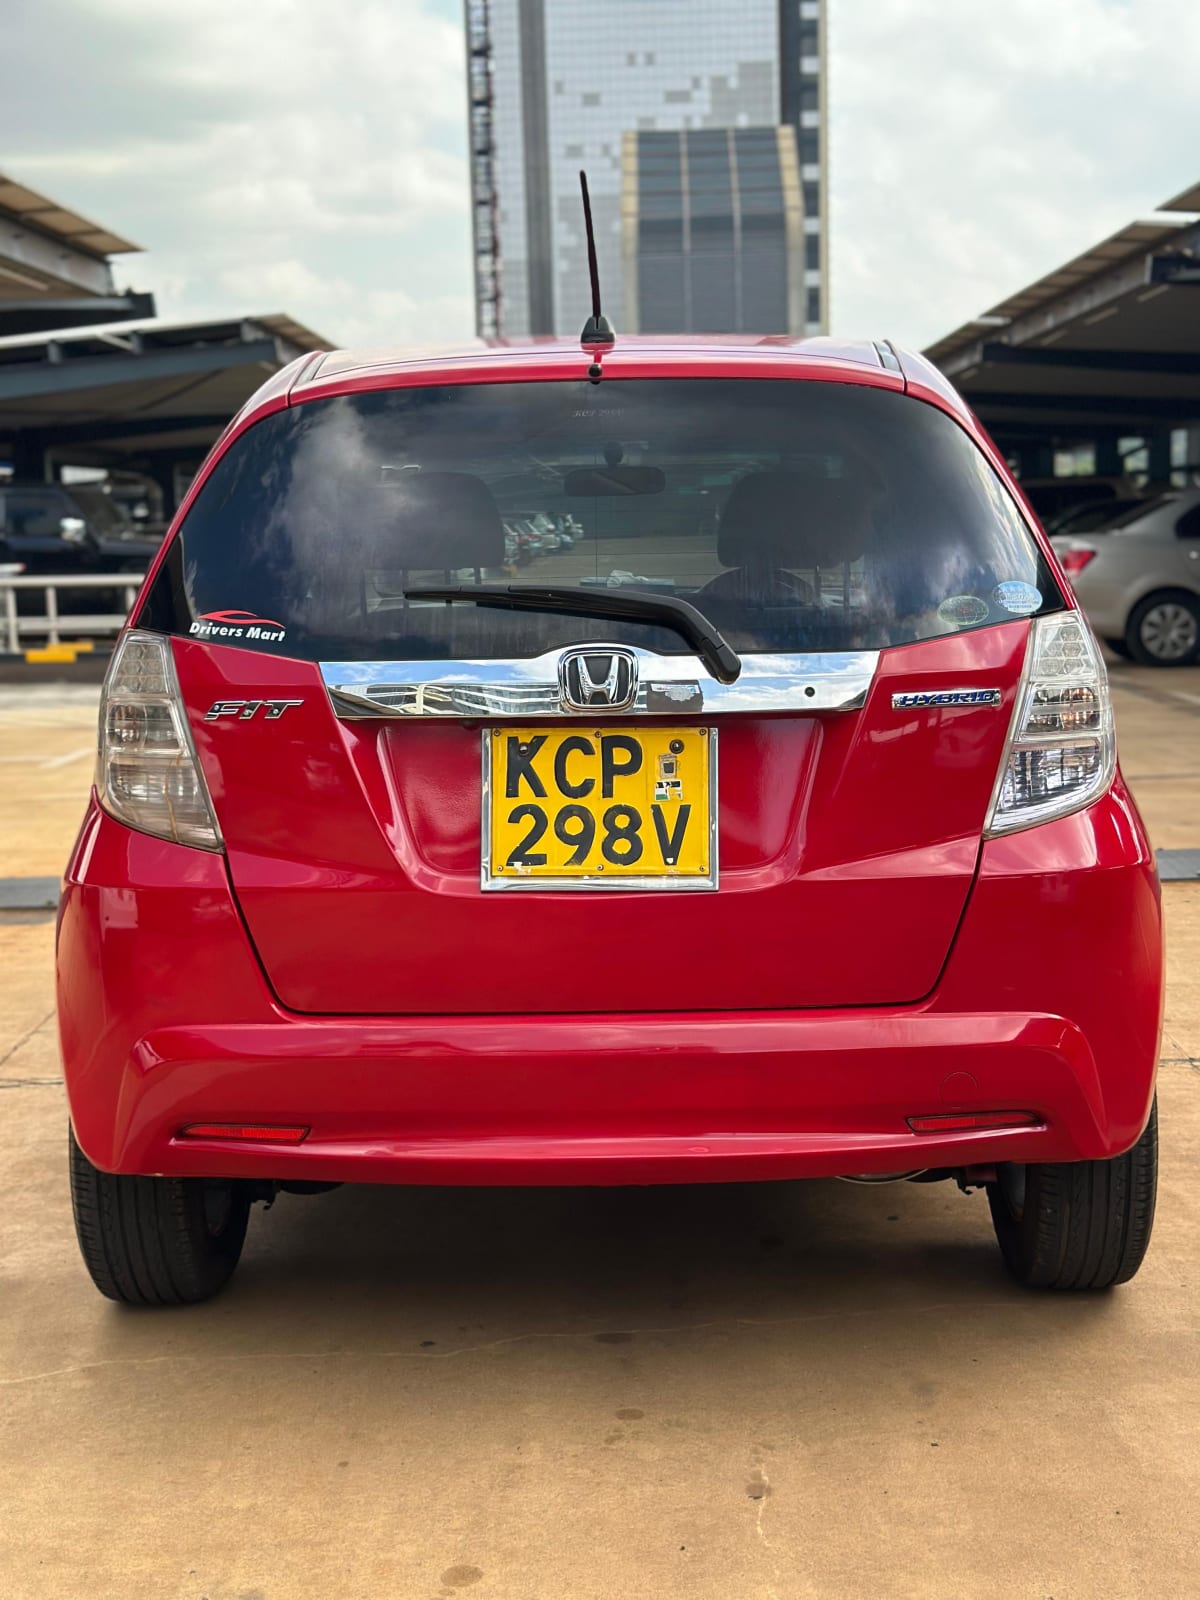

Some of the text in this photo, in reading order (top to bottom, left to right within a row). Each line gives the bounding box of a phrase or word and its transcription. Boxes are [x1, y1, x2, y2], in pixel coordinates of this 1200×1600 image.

[189, 622, 286, 642] Drivers Mart
[899, 689, 995, 706] HYBRID
[203, 699, 305, 720] FIT
[505, 734, 643, 799] KCP
[506, 804, 692, 866] 298V
